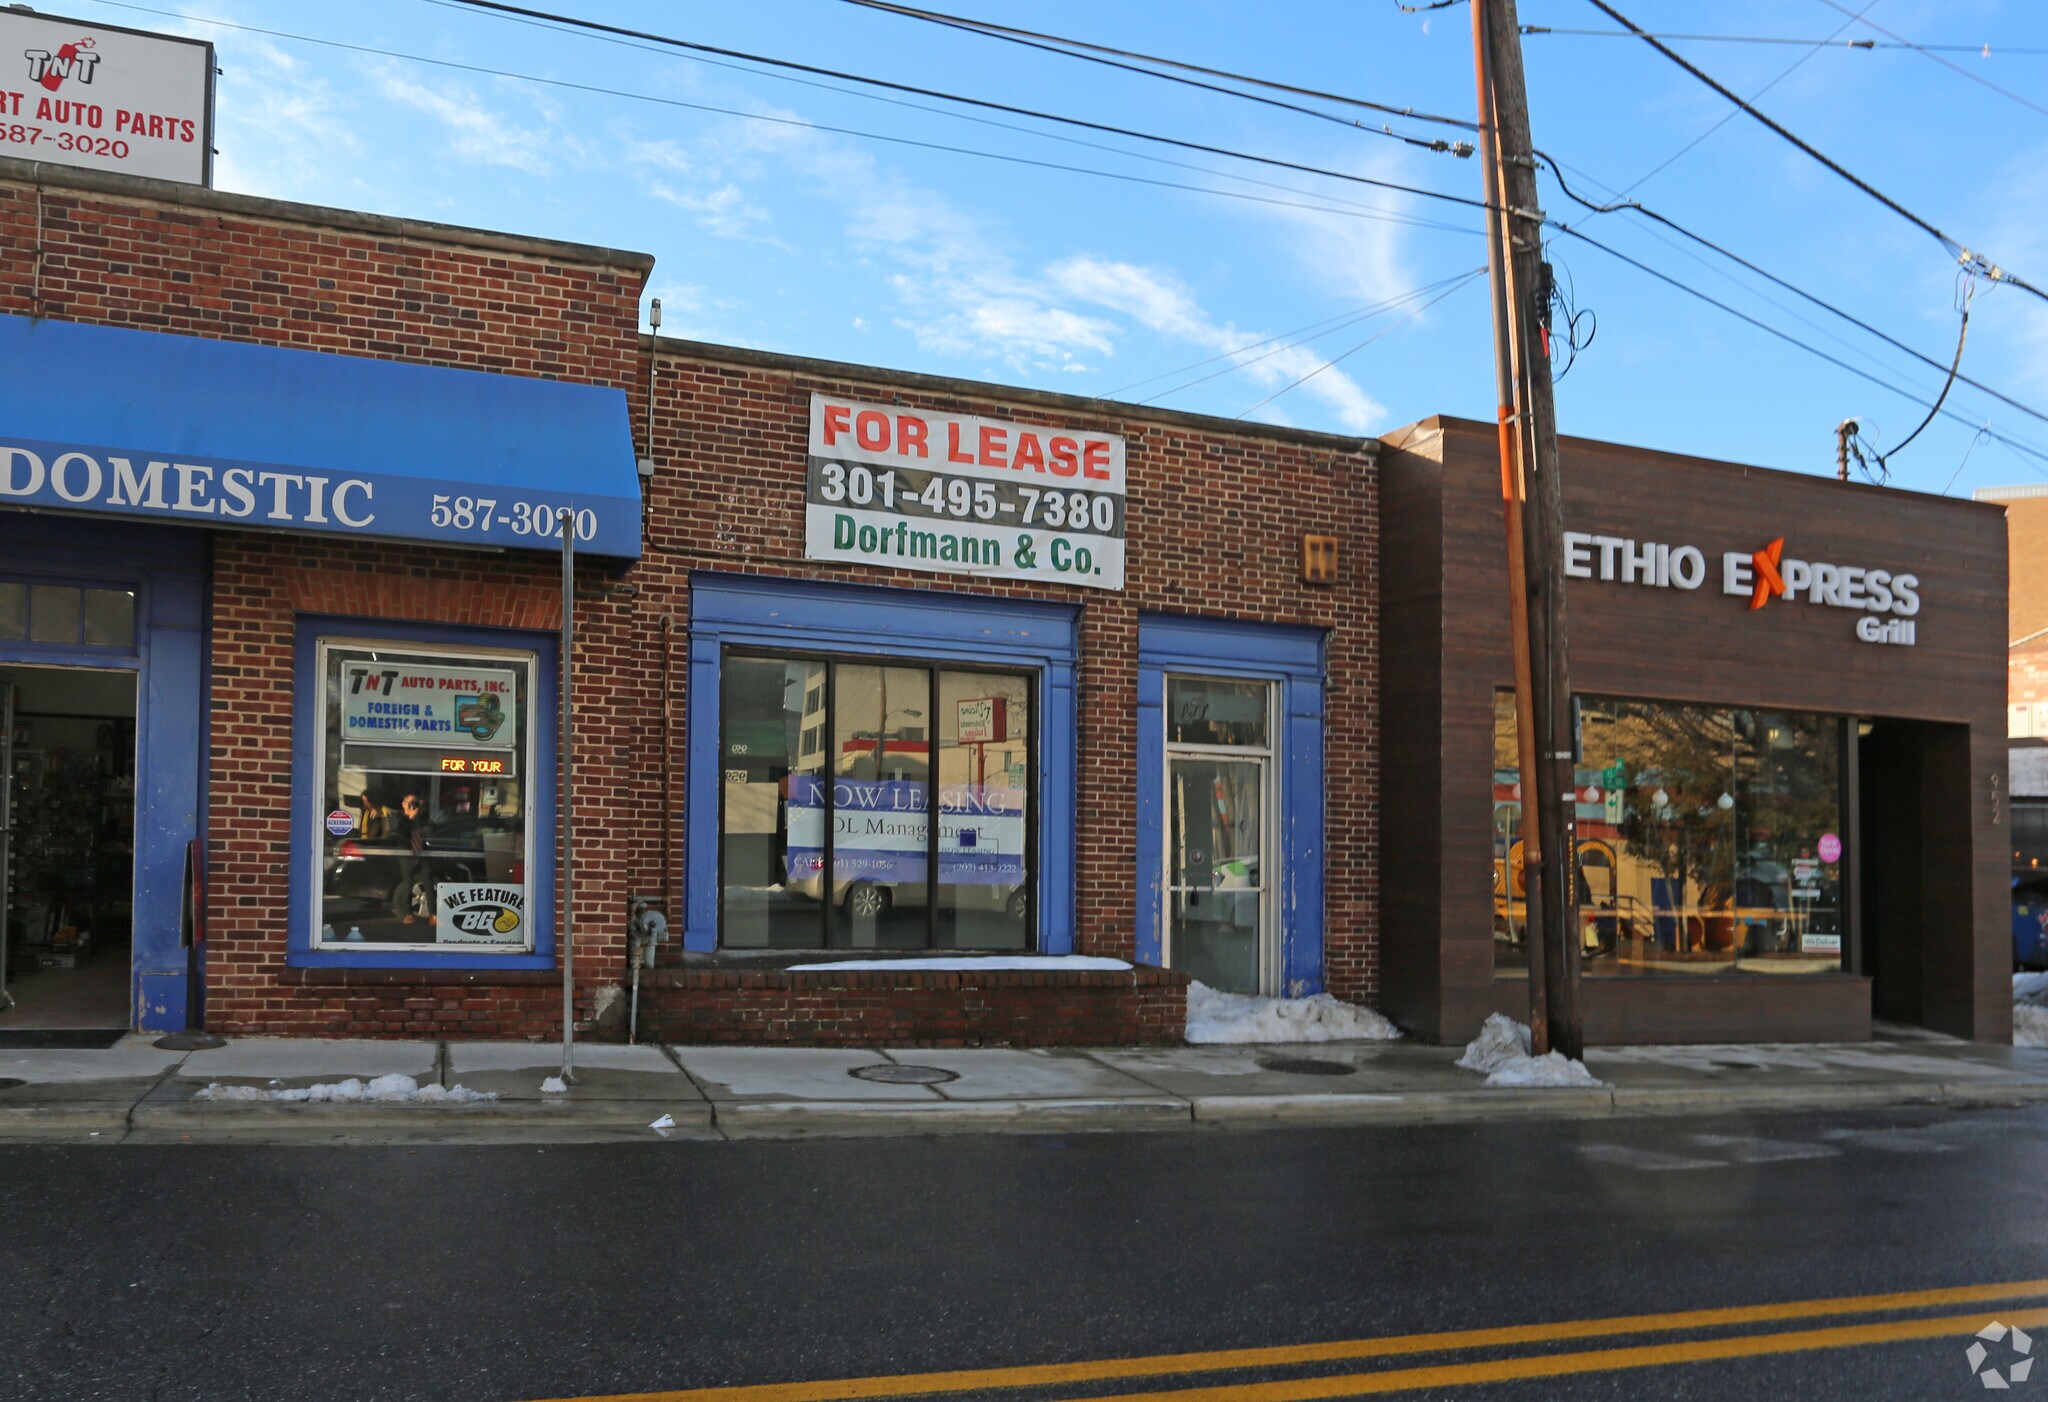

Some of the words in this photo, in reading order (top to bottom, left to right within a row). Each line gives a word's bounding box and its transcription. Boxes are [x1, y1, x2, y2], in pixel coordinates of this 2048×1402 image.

[25, 49, 101, 85] TNT
[36, 97, 103, 129] AUTO
[115, 109, 196, 143] PARTS
[823, 405, 929, 459] FOR
[948, 420, 1111, 481] LEASE
[0, 446, 375, 528] DOMESTIC
[820, 463, 1115, 532] 301-495-7380
[834, 513, 1001, 566] Dorfmann
[1013, 533, 1037, 570] &
[1050, 537, 1101, 575] Co.
[1563, 531, 1706, 590] ETHIO
[1723, 536, 1920, 616] EXPRESS
[1855, 615, 1916, 646] Grill
[349, 668, 399, 696] TNT
[401, 676, 435, 690] AUTO
[438, 678, 482, 694] PARTS,
[484, 680, 511, 693] INC.
[348, 714, 410, 731] DOMESTIC
[413, 719, 452, 732] PARTS
[367, 702, 420, 716] FOREIGN
[424, 704, 434, 717] &
[441, 758, 466, 772] FOR
[470, 760, 502, 773] YOUR
[808, 783, 885, 809] NOW
[892, 787, 1006, 815] LESING
[443, 890, 468, 910] WE
[460, 911, 498, 930] BG
